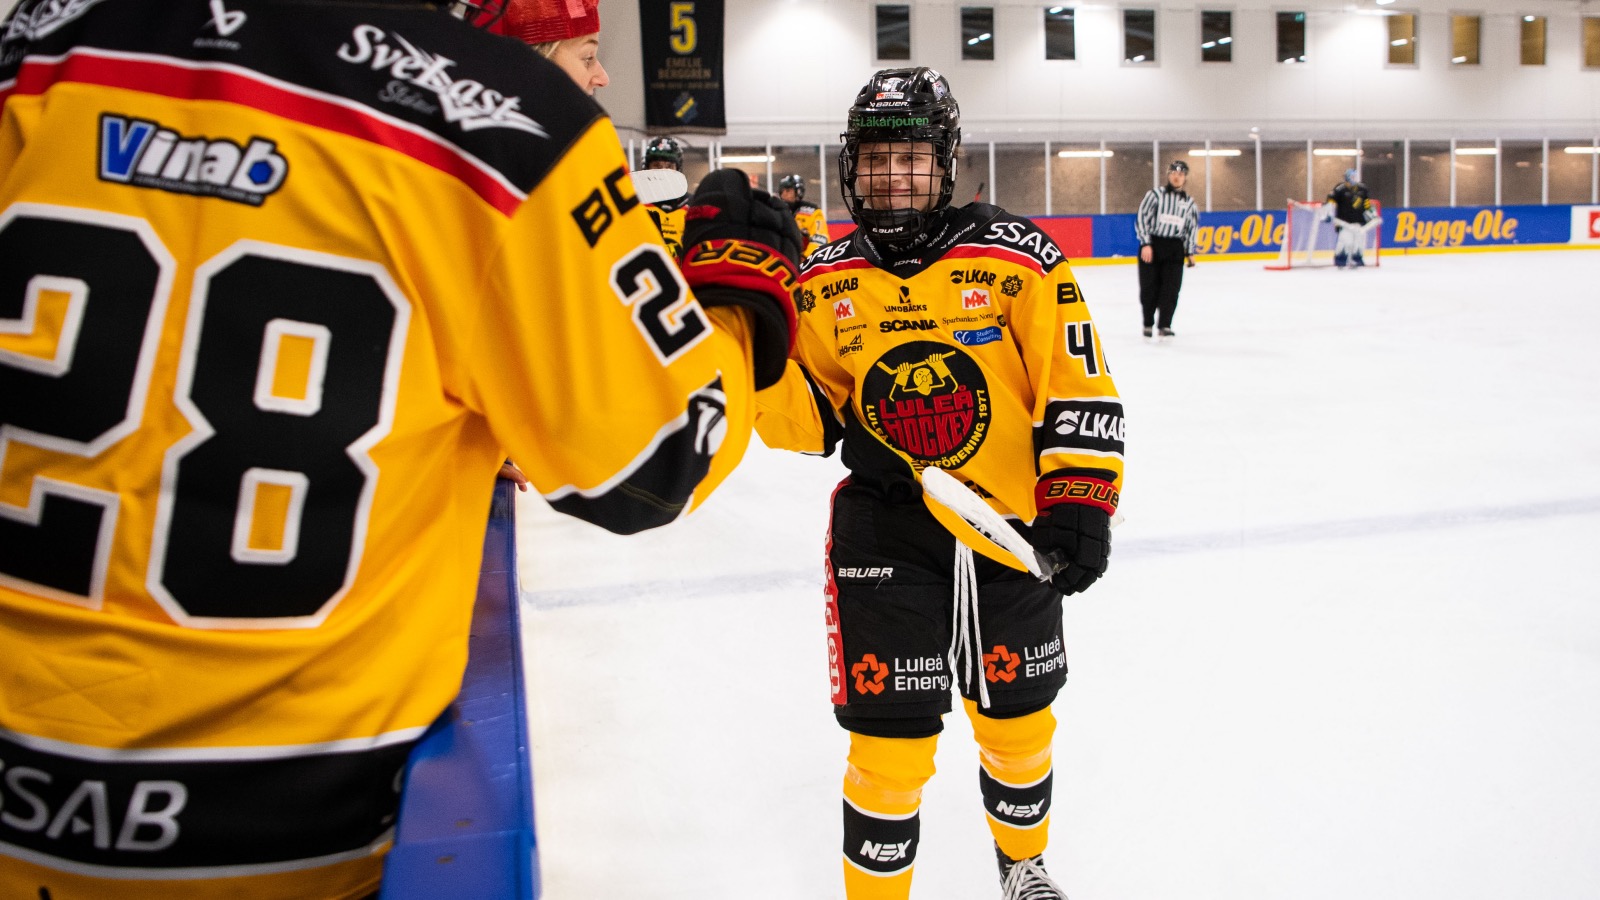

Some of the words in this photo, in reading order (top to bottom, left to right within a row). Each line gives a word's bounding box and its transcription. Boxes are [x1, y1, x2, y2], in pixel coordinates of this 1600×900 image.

[669, 2, 697, 54] 5
[99, 114, 287, 196] Vinab
[984, 222, 1062, 265] SSAB
[830, 277, 859, 296] LKAB
[965, 269, 996, 287] LKAB
[884, 303, 928, 313] LINDBÄCKS
[964, 290, 989, 309] MAX
[879, 319, 940, 333] SCANIA
[942, 316, 979, 326] Sparbanken
[979, 313, 994, 321] Nord
[1065, 320, 1111, 378] 4
[880, 385, 974, 419] LULEÅ
[976, 389, 988, 418] 1977
[0, 202, 412, 629] 28
[882, 409, 974, 456] HOCKEY
[1024, 635, 1061, 661] Luleå
[895, 653, 943, 673] Luleå
[0, 762, 188, 851] SAB
[995, 798, 1045, 819] NEX
[859, 838, 912, 862] NEX
